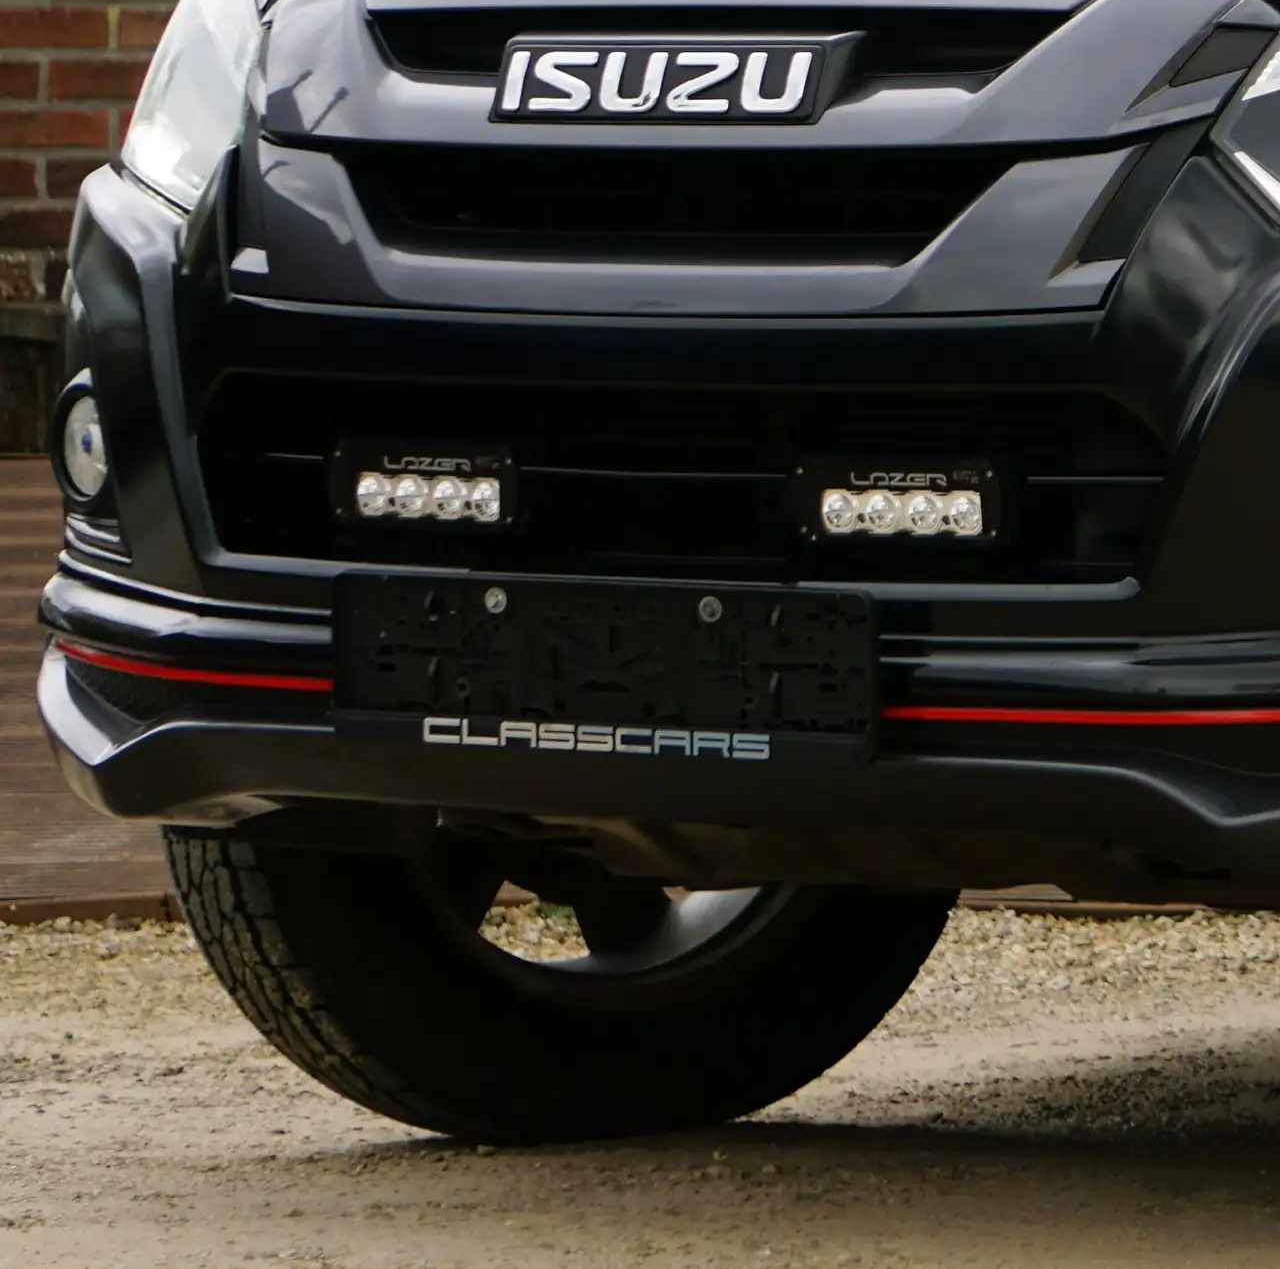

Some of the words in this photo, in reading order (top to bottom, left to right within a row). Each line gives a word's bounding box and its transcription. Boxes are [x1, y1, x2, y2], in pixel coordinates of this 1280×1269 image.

[501, 51, 812, 114] ISUZU
[383, 454, 472, 472] LAZER
[850, 471, 948, 487] LAZER
[423, 716, 770, 760] CLASSCARS
